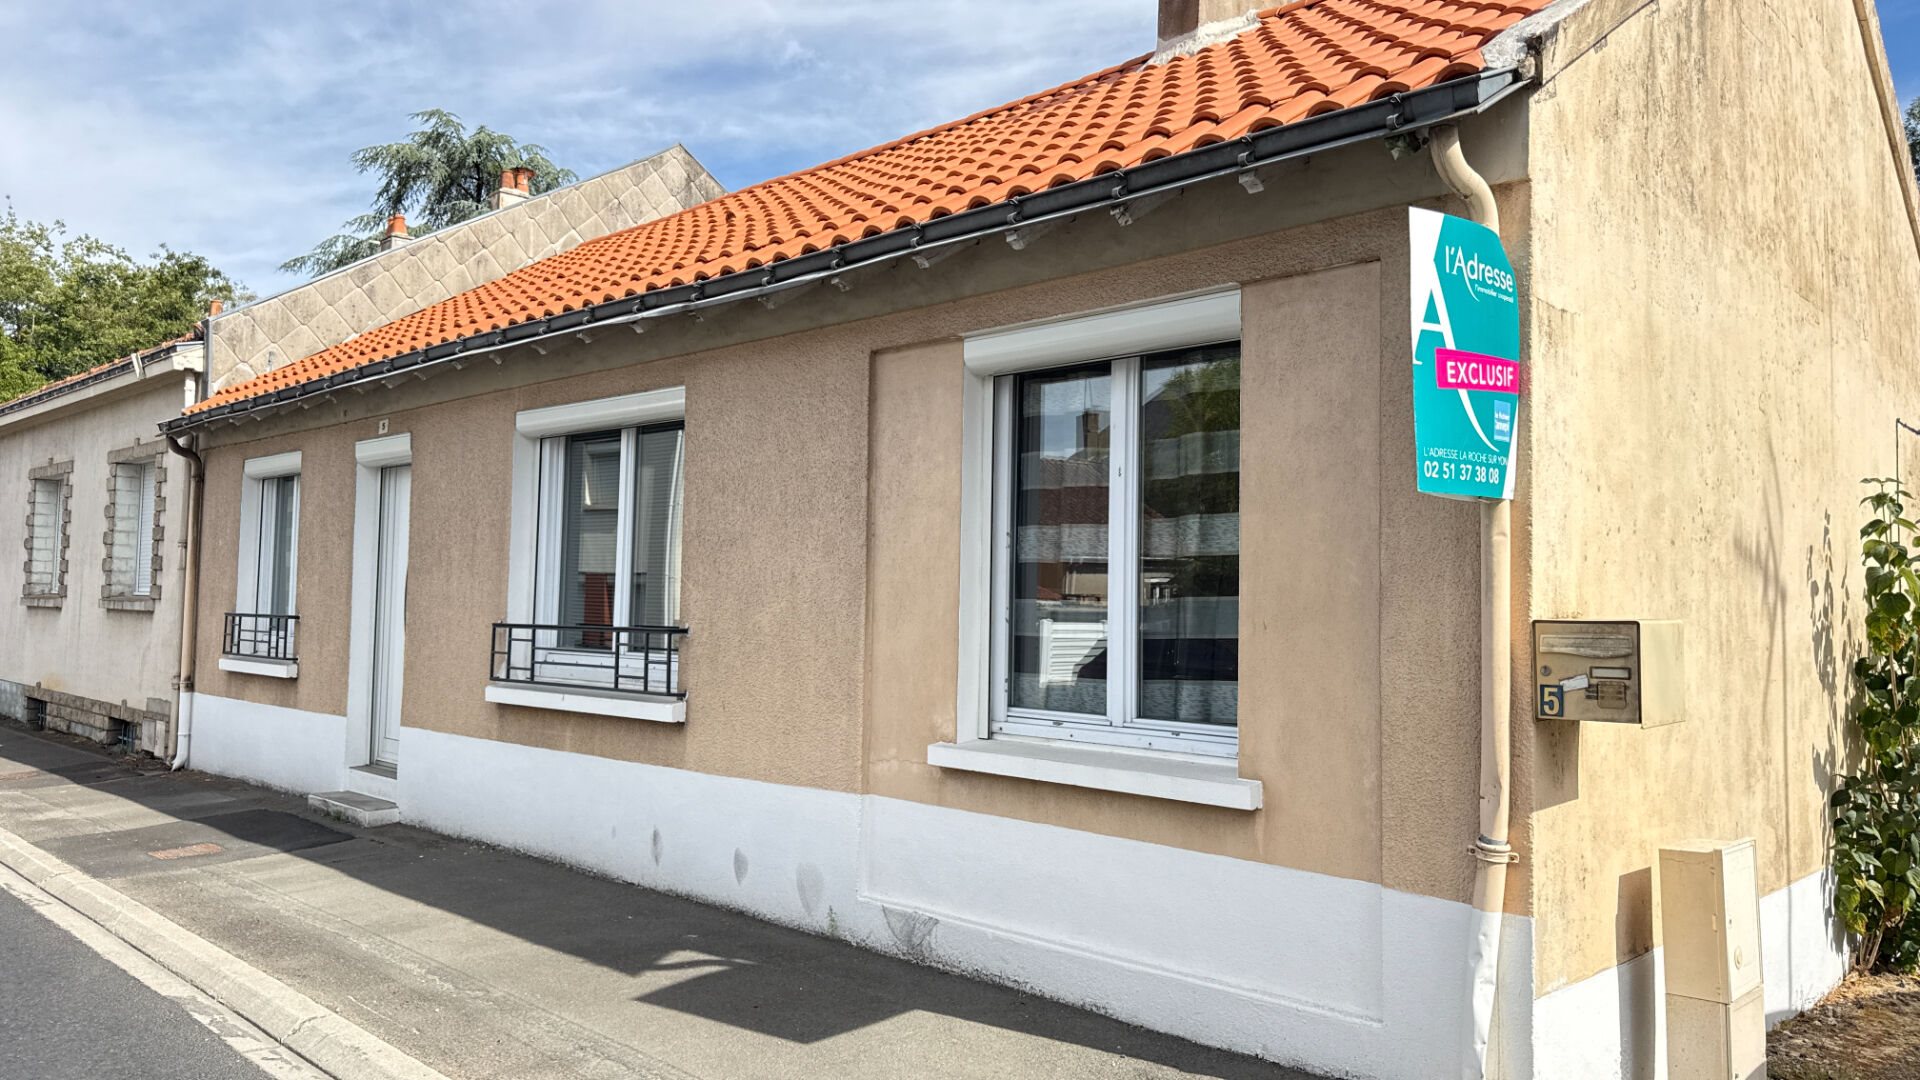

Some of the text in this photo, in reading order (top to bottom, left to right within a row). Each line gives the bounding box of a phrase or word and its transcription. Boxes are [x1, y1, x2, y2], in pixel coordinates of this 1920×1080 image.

[1445, 245, 1513, 302] l'Adresse
[1446, 361, 1513, 387] EXCLUSIF
[1423, 447, 1458, 460] L'ADRESSE
[1459, 451, 1467, 461] LA
[1468, 452, 1487, 464] ROCHE
[1424, 460, 1499, 485] 02 51 37 38 08
[1543, 688, 1560, 715] 5
